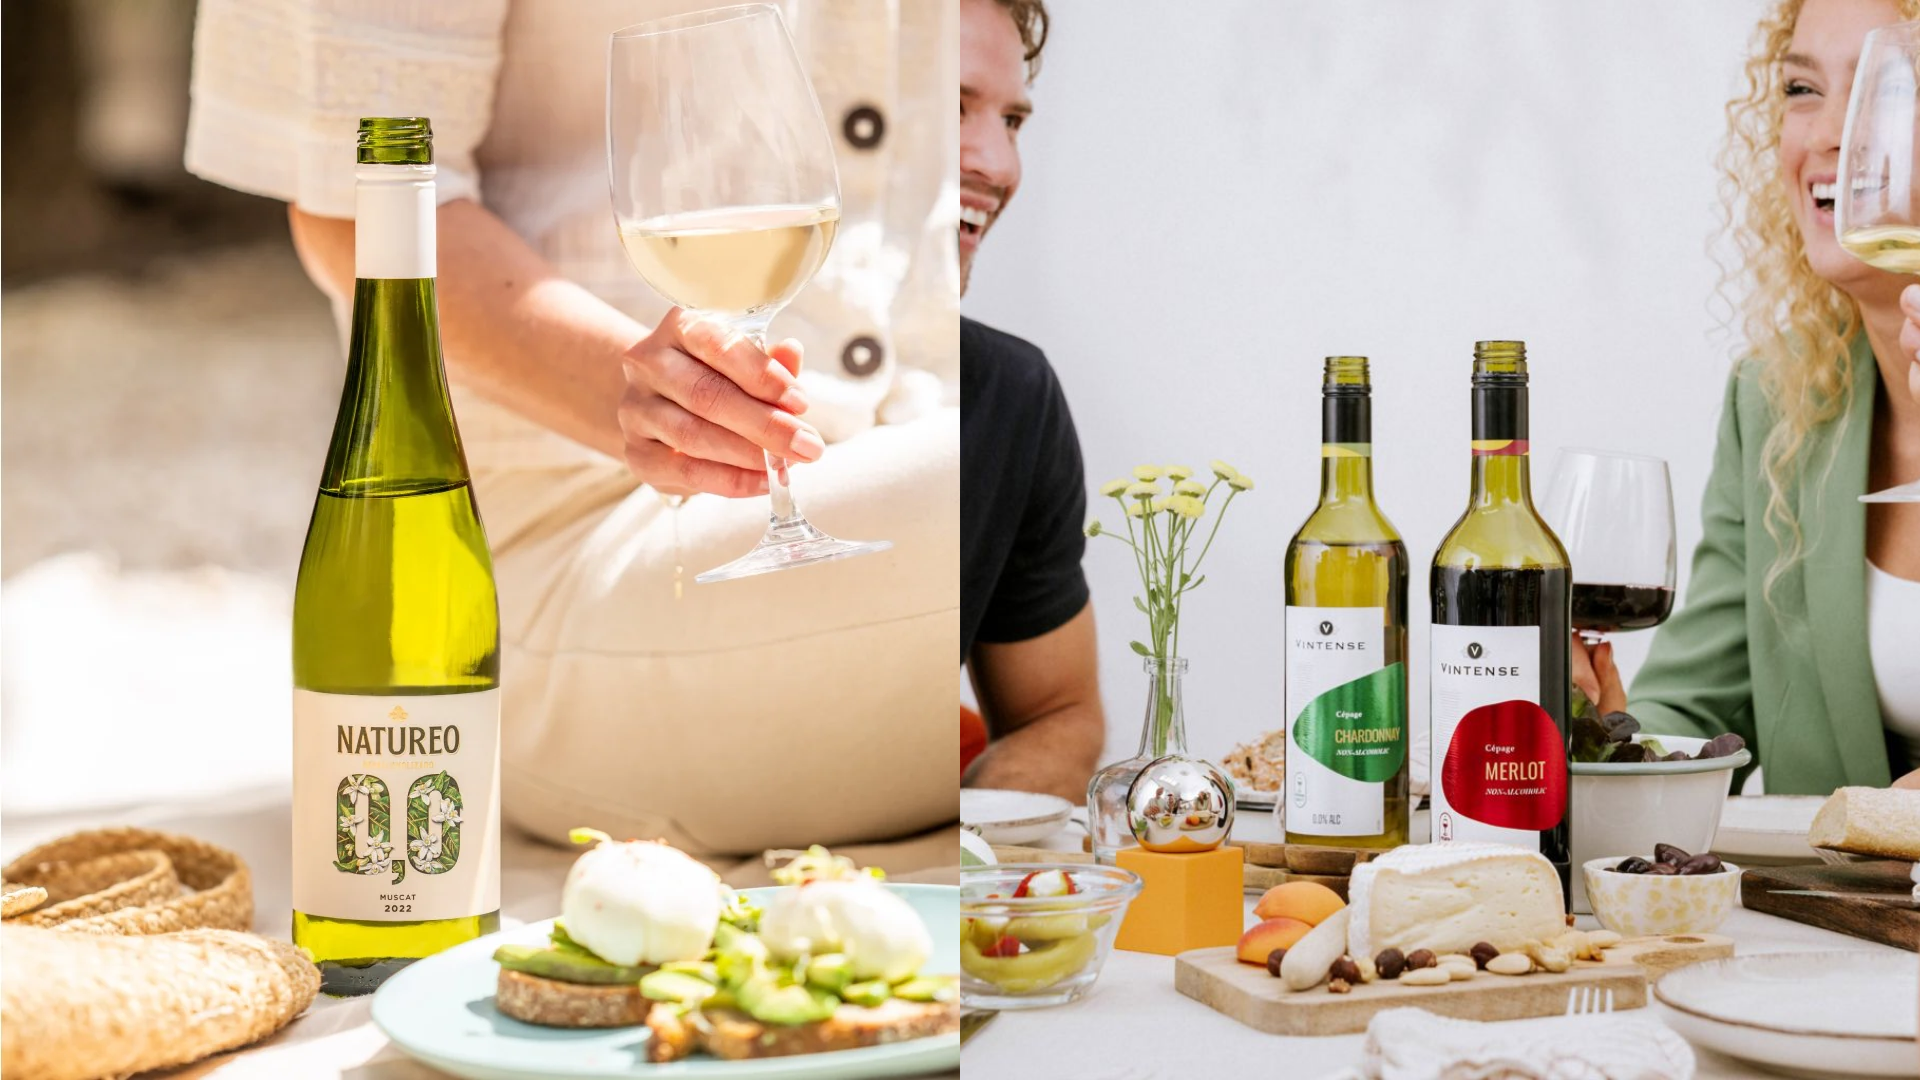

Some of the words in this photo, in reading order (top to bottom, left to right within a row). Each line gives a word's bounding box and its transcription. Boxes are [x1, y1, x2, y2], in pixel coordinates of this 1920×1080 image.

[1295, 639, 1365, 650] VINTENSE
[1441, 663, 1519, 676] VINTENSE
[1336, 710, 1363, 719] Cépage
[337, 725, 460, 755] NATUREO
[1335, 727, 1400, 744] CHARDONNAY
[1336, 747, 1390, 756] NON-ALCOHOLIC
[1485, 744, 1515, 753] Cépage
[1485, 761, 1546, 781] MERLOT
[1485, 787, 1547, 796] NON-ALCOHOLIC
[333, 770, 464, 885] 0,0
[385, 905, 412, 913] 2022
